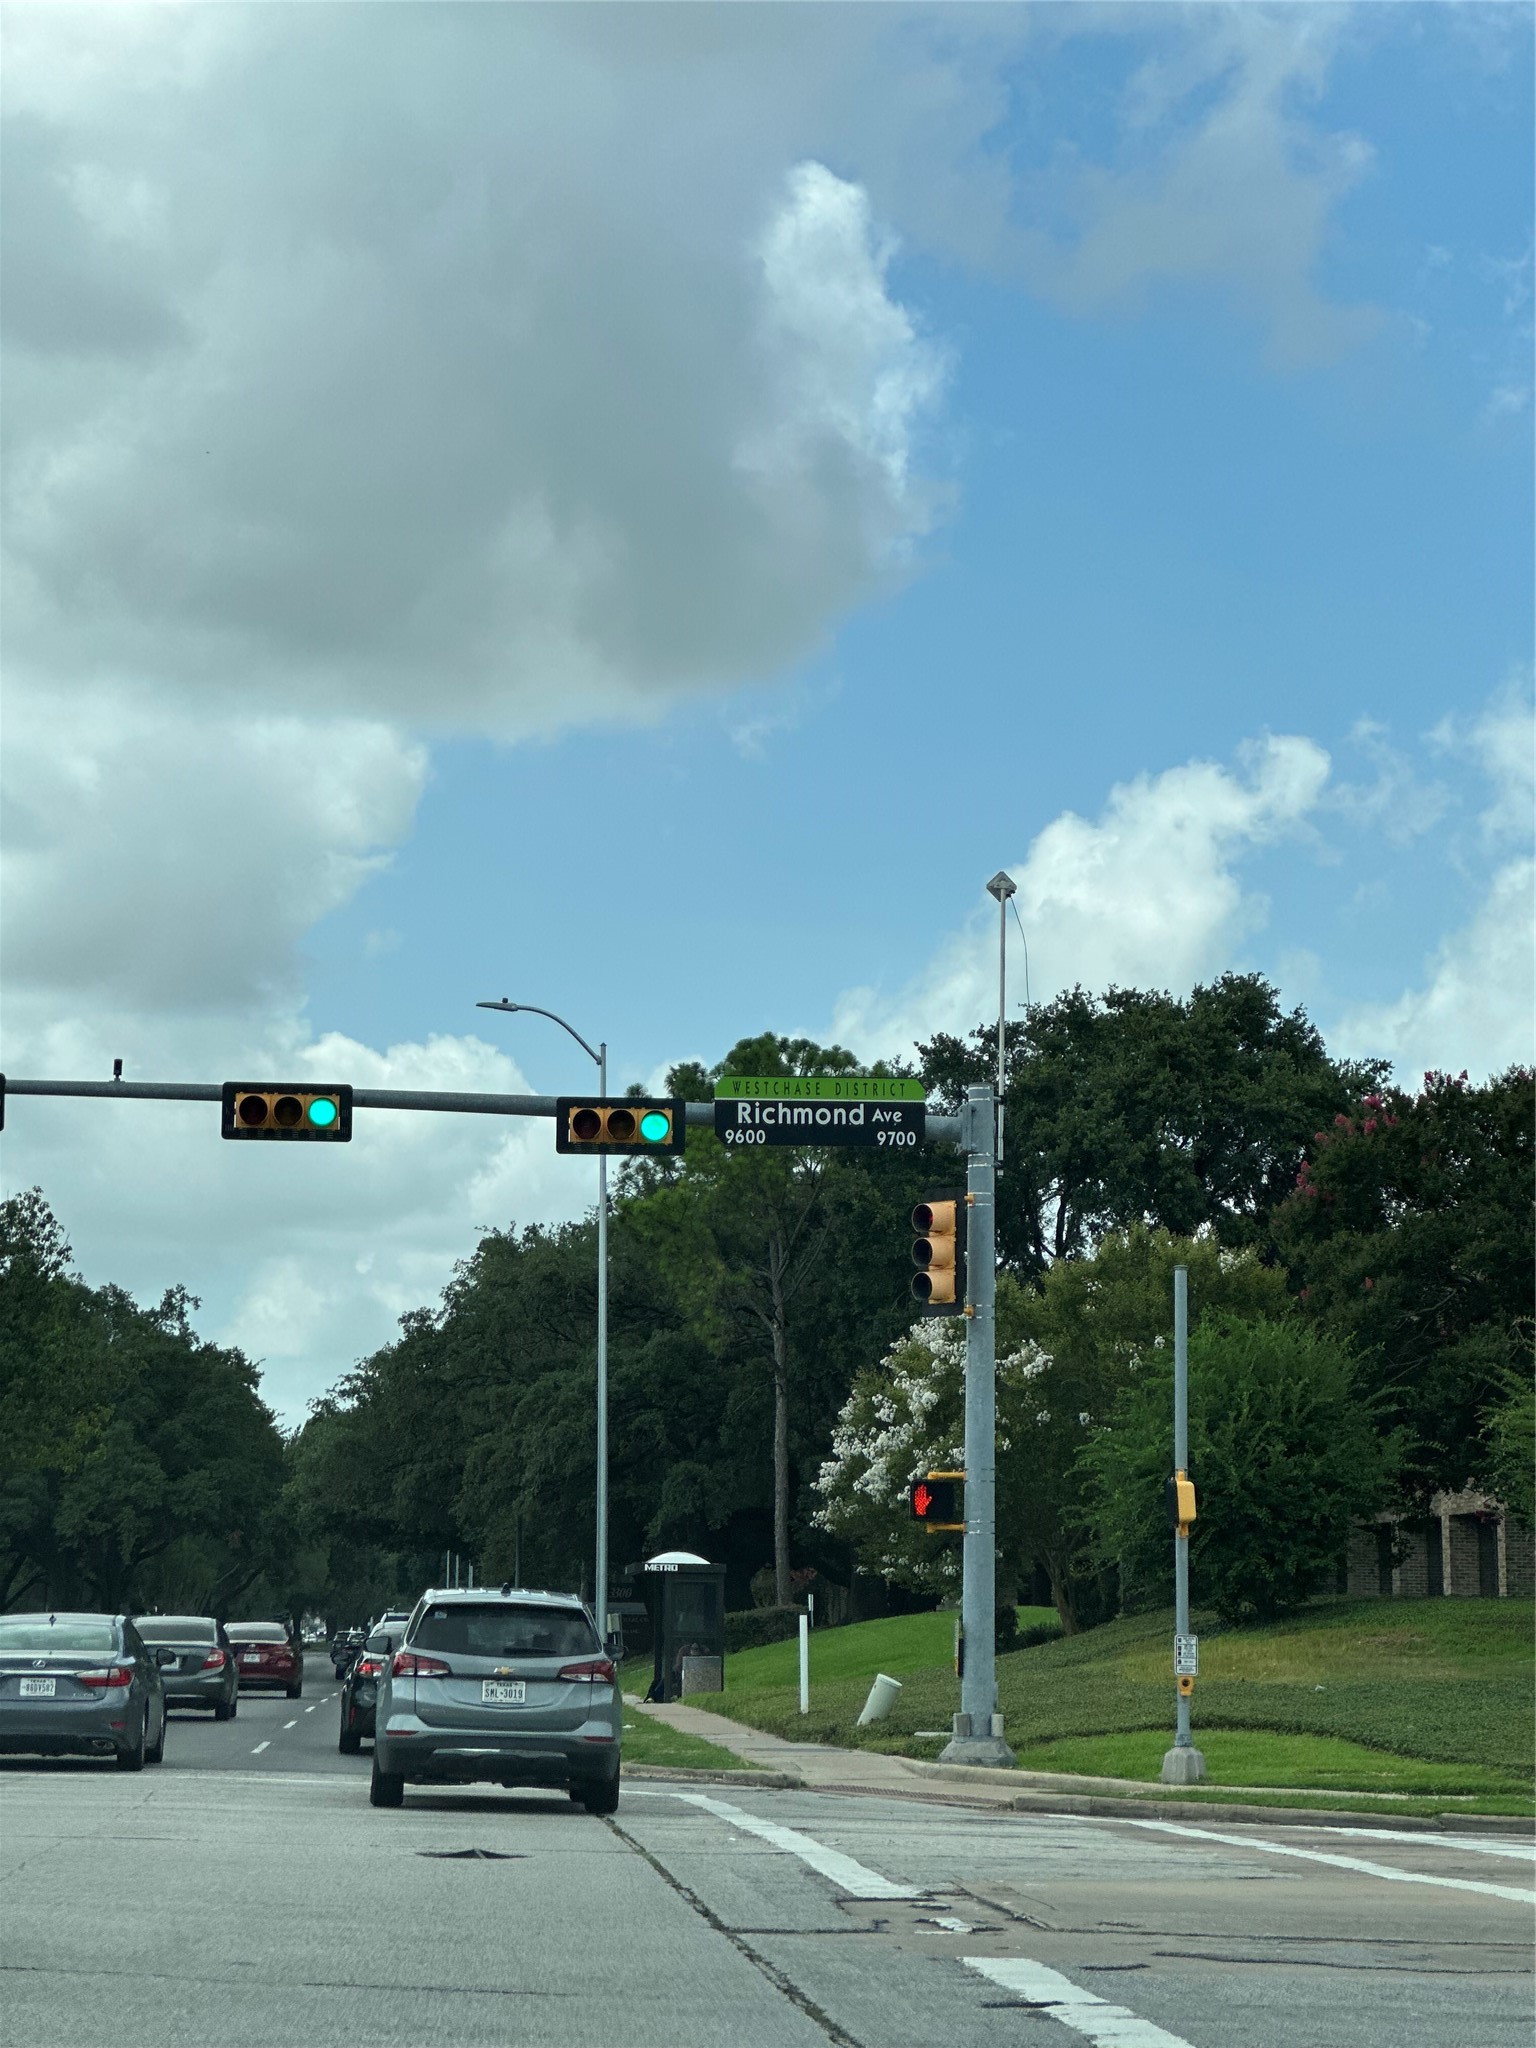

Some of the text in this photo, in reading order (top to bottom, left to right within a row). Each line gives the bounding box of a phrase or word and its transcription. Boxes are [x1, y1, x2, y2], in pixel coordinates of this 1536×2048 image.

[732, 1080, 906, 1097] WESTCHASE DISTRICT
[737, 1101, 903, 1125] Richmond Ave
[724, 1129, 917, 1146] 9600 9700
[644, 1563, 679, 1572] METRO
